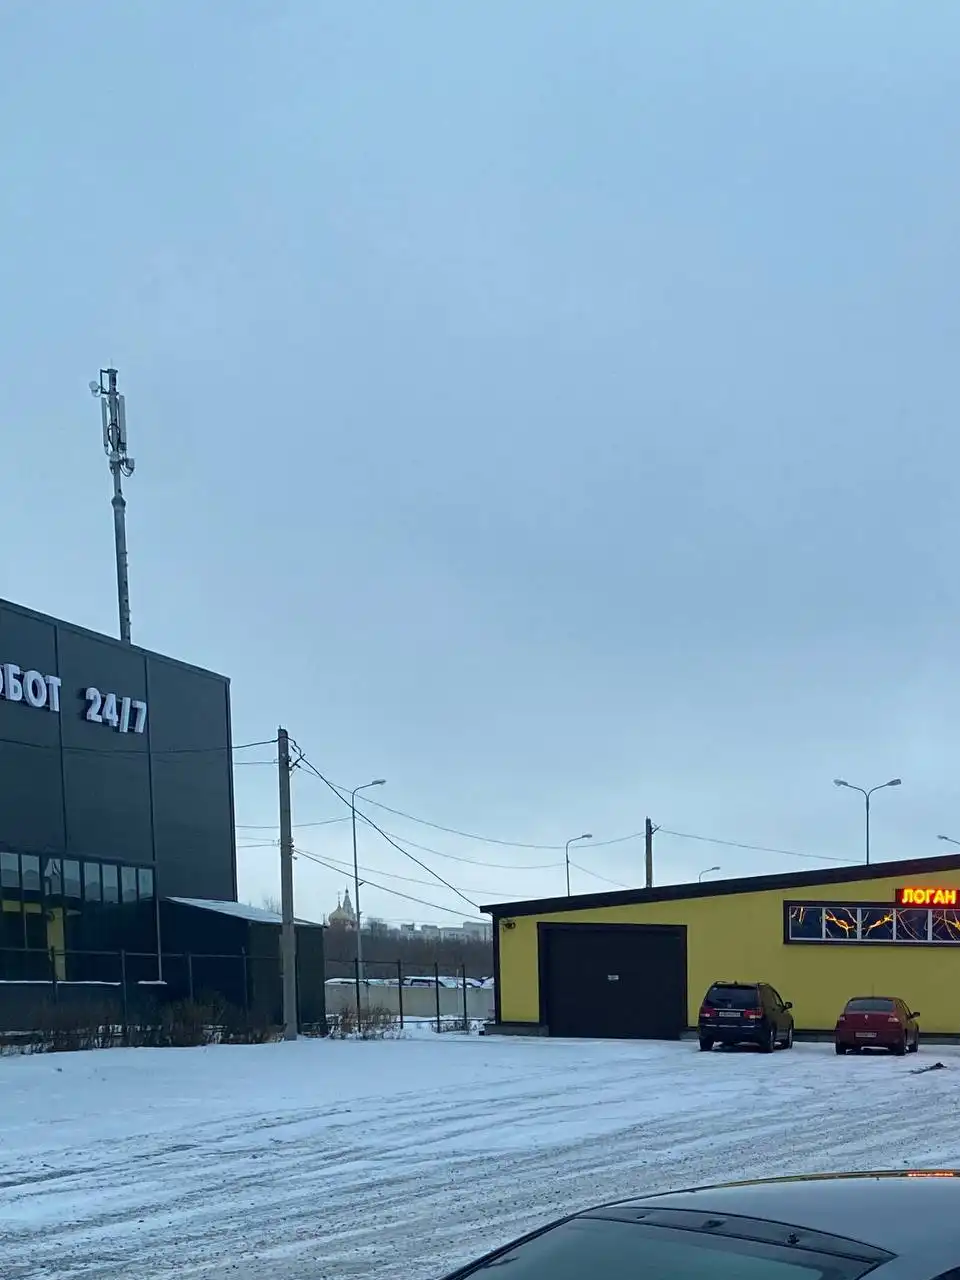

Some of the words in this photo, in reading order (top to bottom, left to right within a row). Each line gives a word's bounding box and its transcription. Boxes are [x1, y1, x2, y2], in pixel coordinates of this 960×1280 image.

[0, 663, 61, 712] БОТ
[86, 687, 147, 733] 24/7
[901, 888, 957, 905] ЛОГАН
